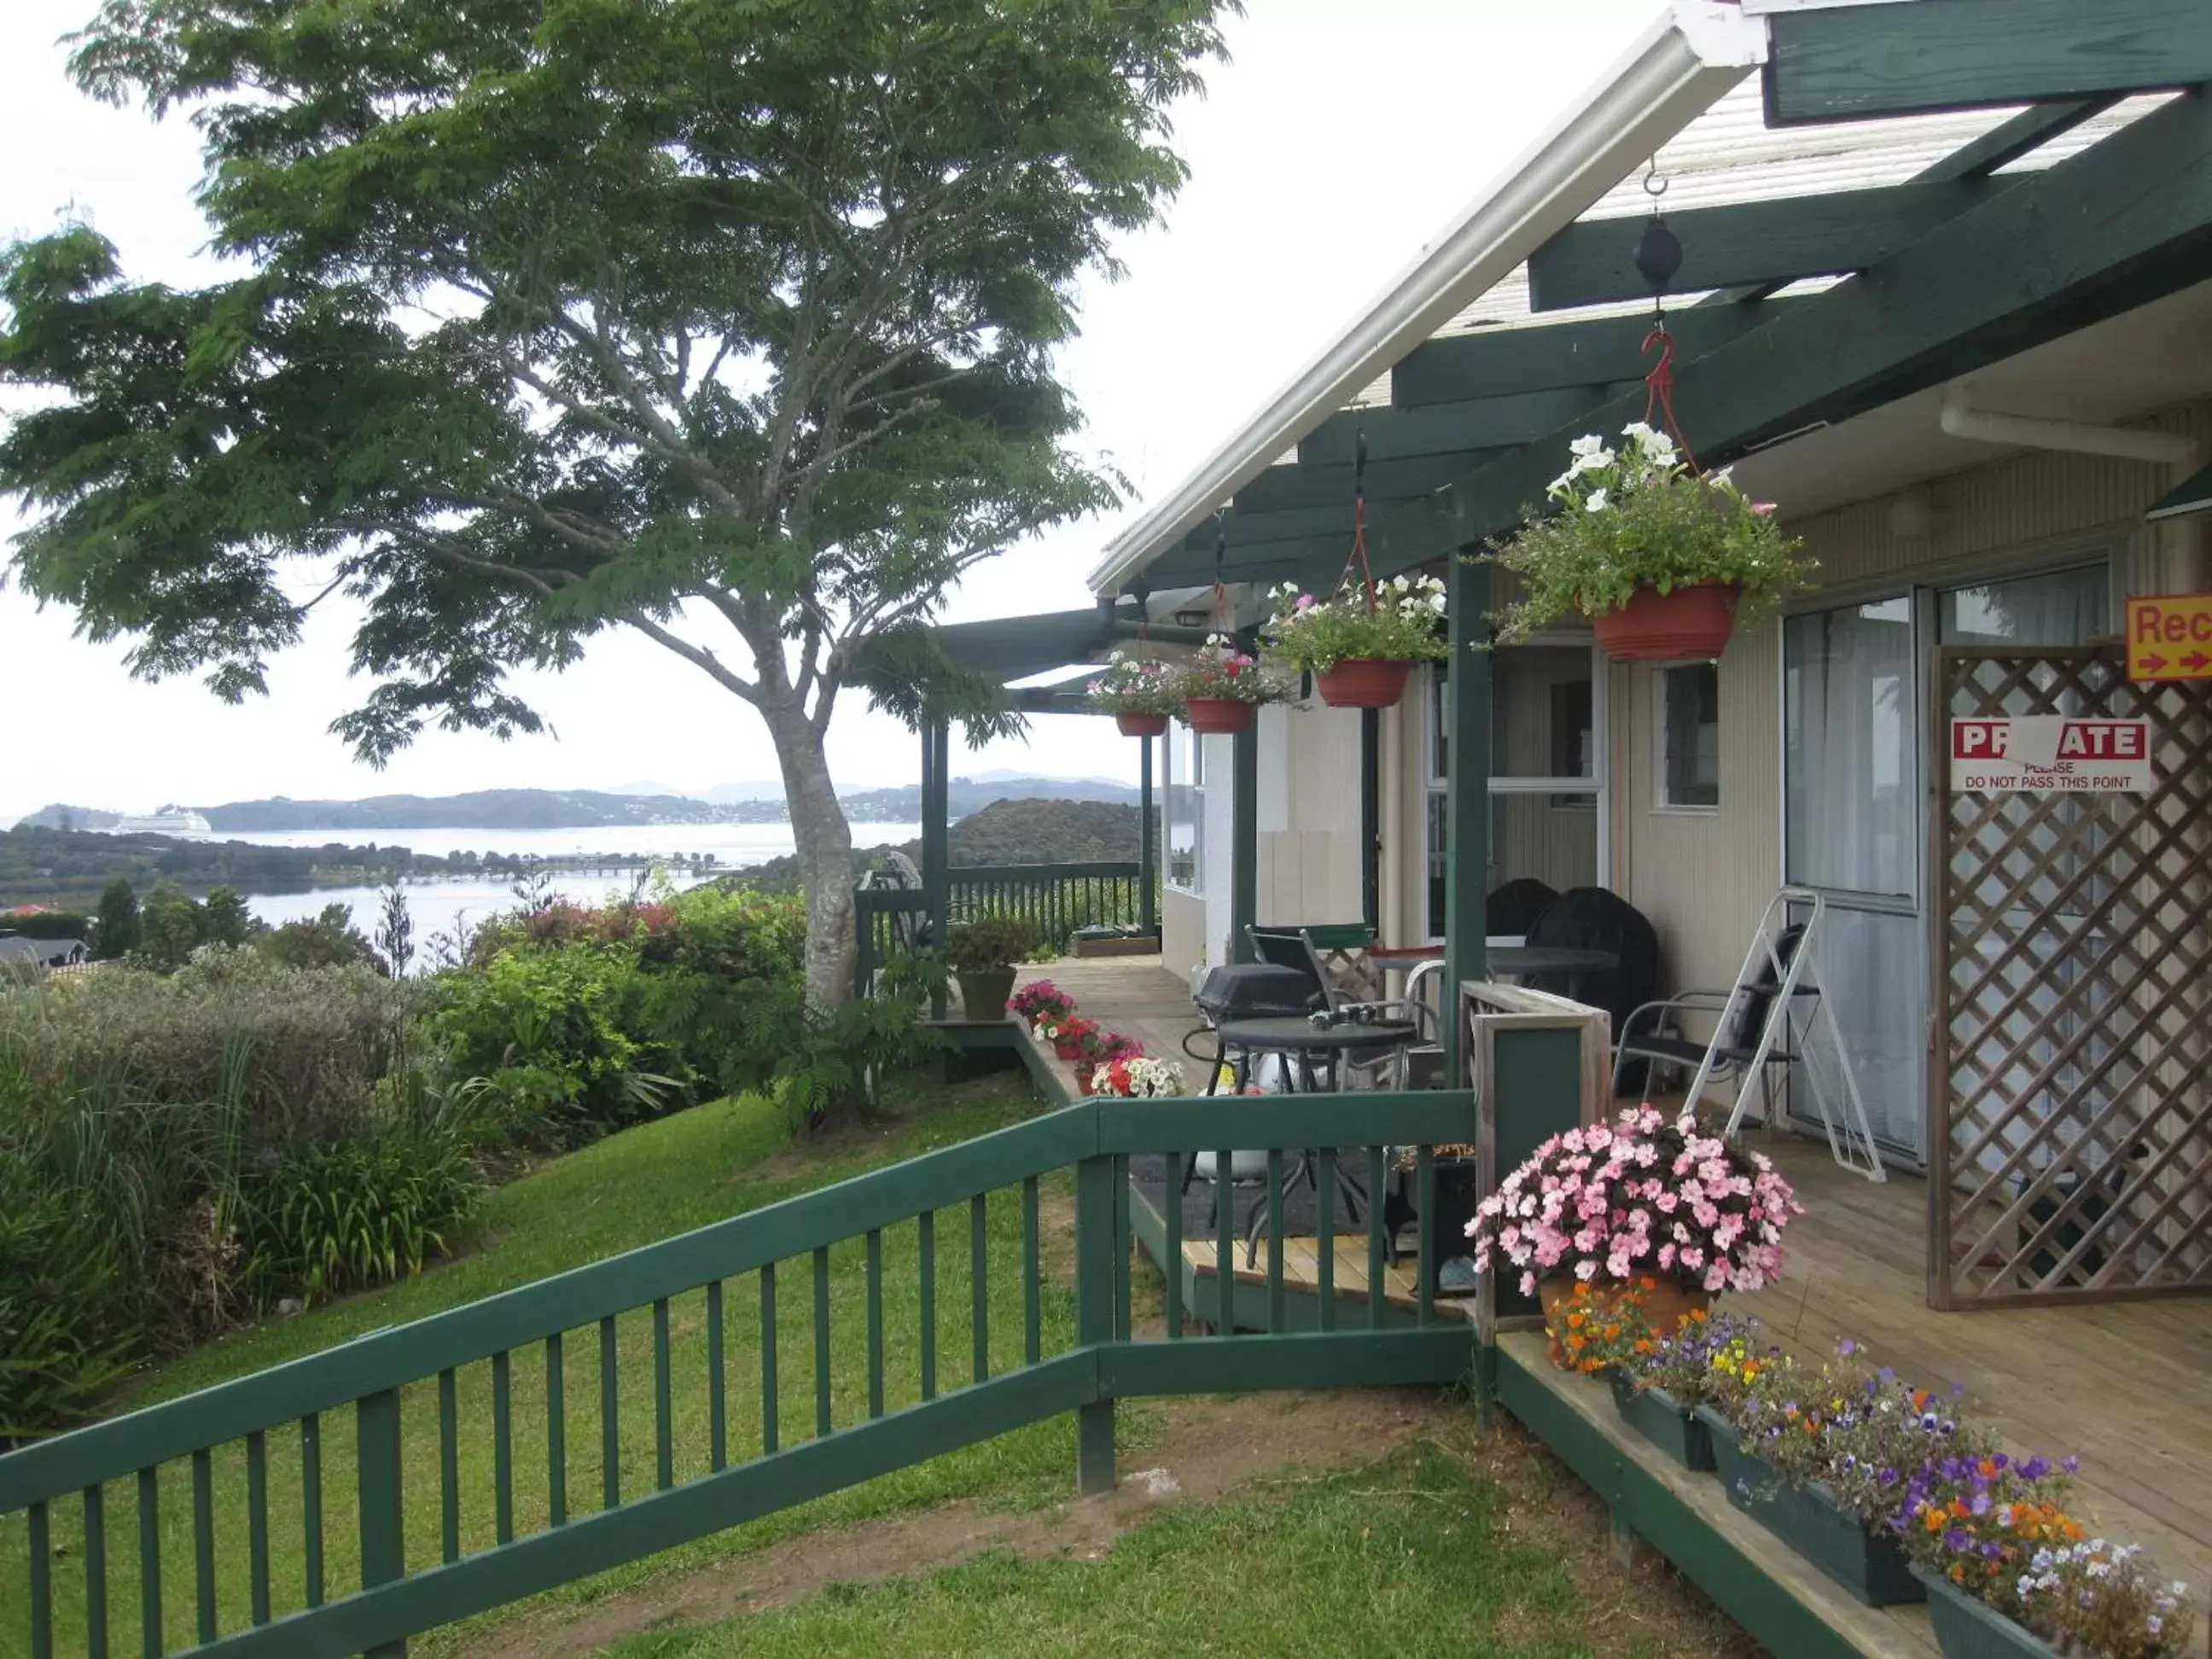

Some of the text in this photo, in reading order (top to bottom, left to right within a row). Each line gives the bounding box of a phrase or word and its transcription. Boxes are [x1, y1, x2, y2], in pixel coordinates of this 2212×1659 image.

[1963, 725, 2136, 754] PRATE
[1965, 776, 2132, 789] DO NOT PASS THIS POINT
